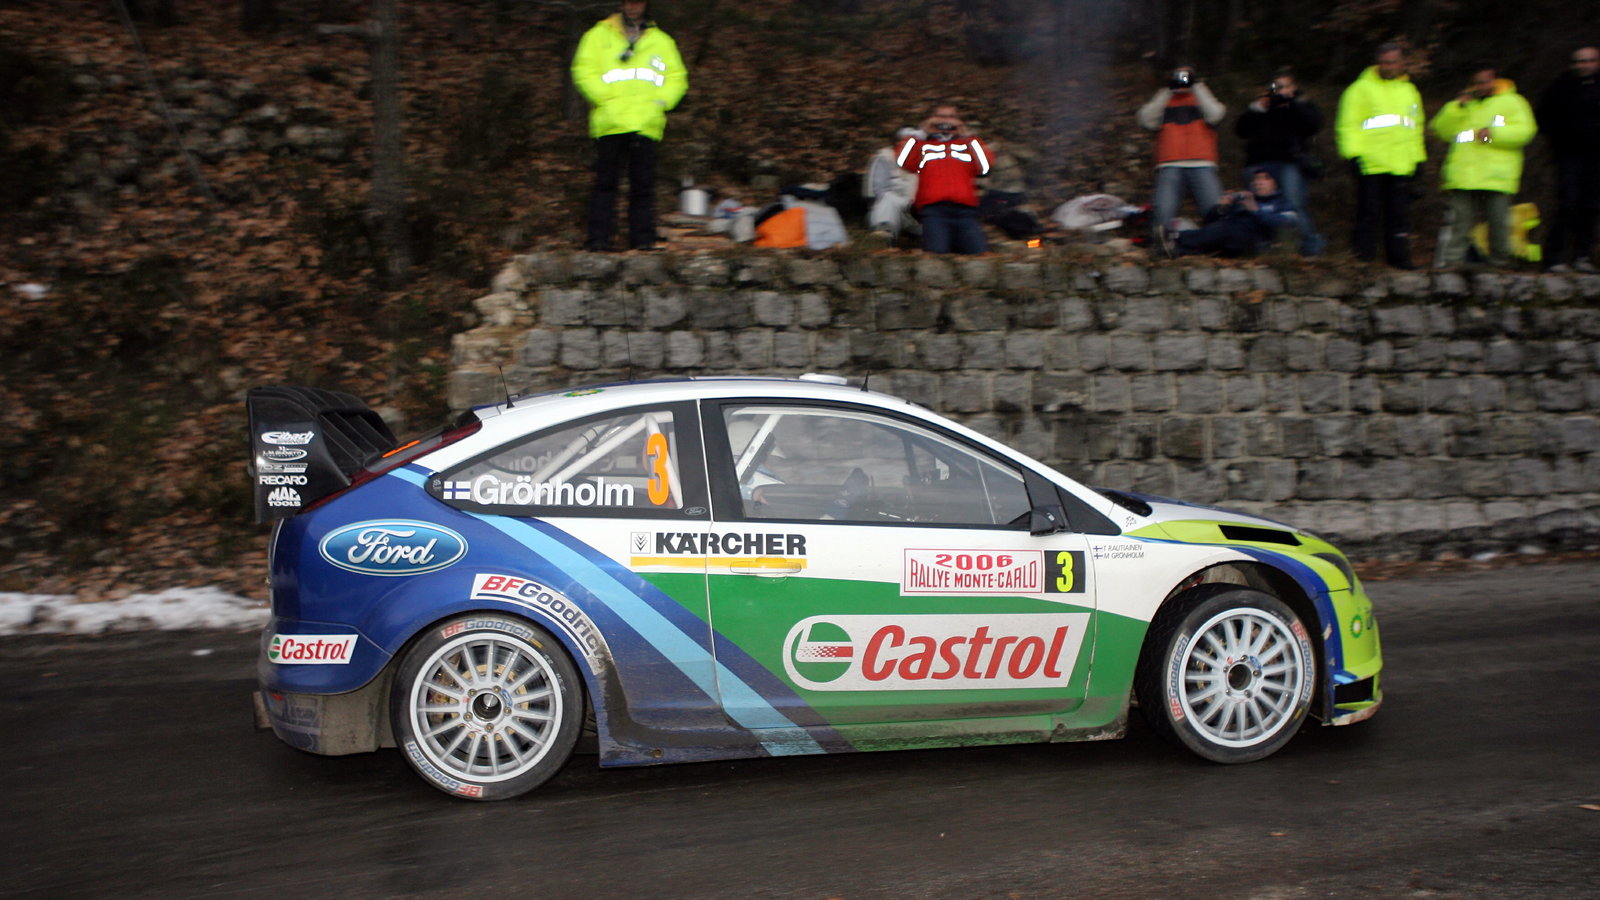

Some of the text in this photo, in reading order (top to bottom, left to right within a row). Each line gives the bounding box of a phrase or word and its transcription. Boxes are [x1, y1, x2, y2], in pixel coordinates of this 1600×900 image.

[260, 475, 308, 486] RECARO
[647, 433, 669, 505] 3
[268, 487, 301, 501] MAC
[473, 474, 634, 506] Grönholm
[347, 528, 438, 565] Ford
[656, 532, 807, 555] KÄRCHER
[910, 558, 950, 588] RALLYE
[935, 553, 1013, 571] 2006
[1056, 551, 1074, 592] 3
[443, 619, 532, 640] BFGoodrich
[281, 638, 349, 660] Castrol
[861, 624, 1069, 681] Castrol
[1292, 621, 1314, 702] BFGoodrich
[1167, 636, 1188, 720] BFGoodrich
[407, 741, 482, 797] BFGoodrich
